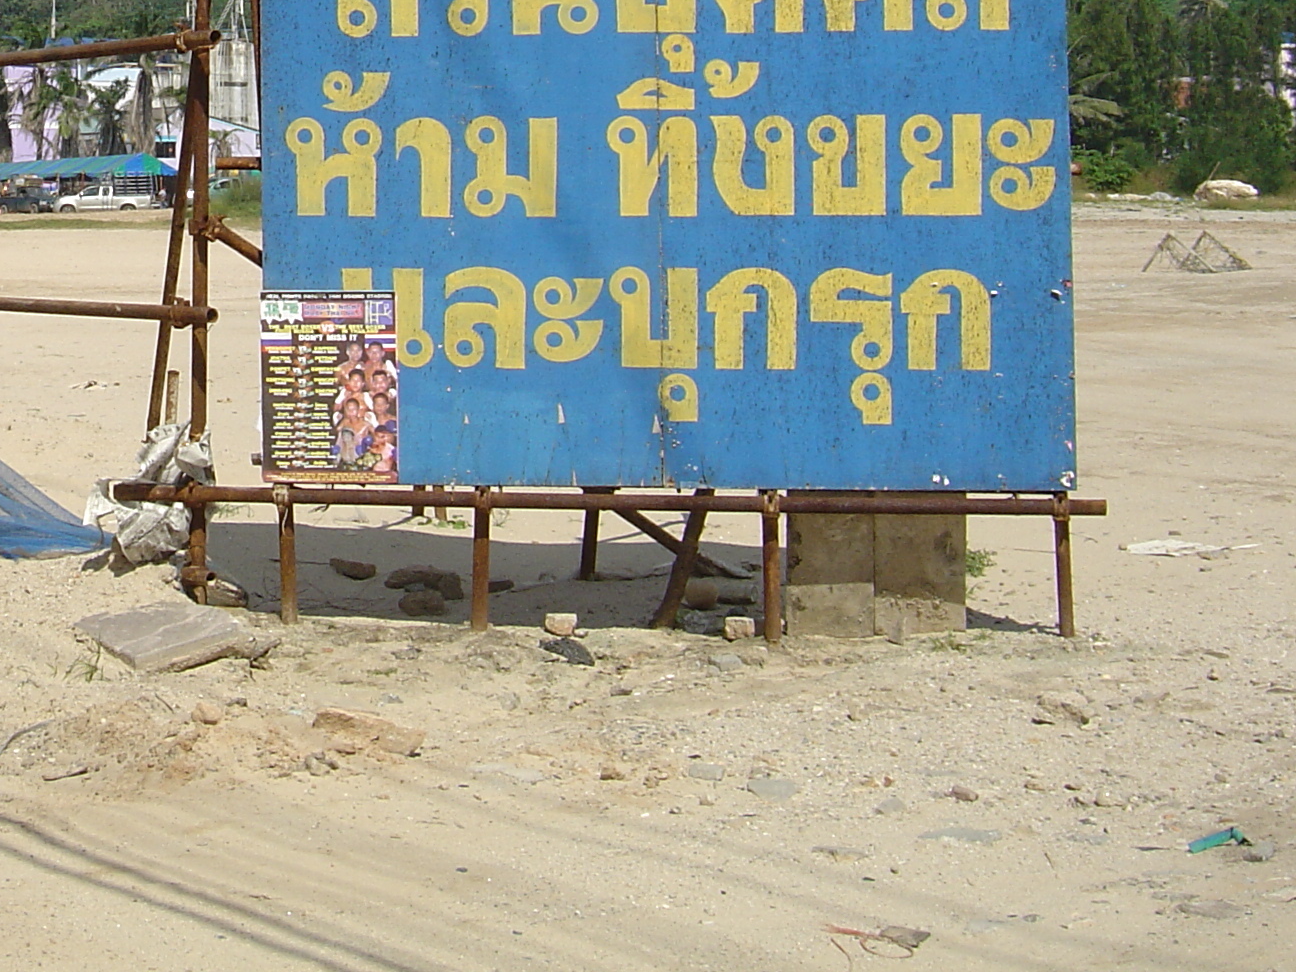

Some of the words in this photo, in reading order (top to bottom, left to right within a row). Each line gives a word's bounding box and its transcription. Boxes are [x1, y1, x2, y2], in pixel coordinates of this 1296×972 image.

[286, 71, 558, 219] ห้าม
[606, 60, 1056, 218] ทิ้งขยะ
[349, 334, 358, 342] IT
